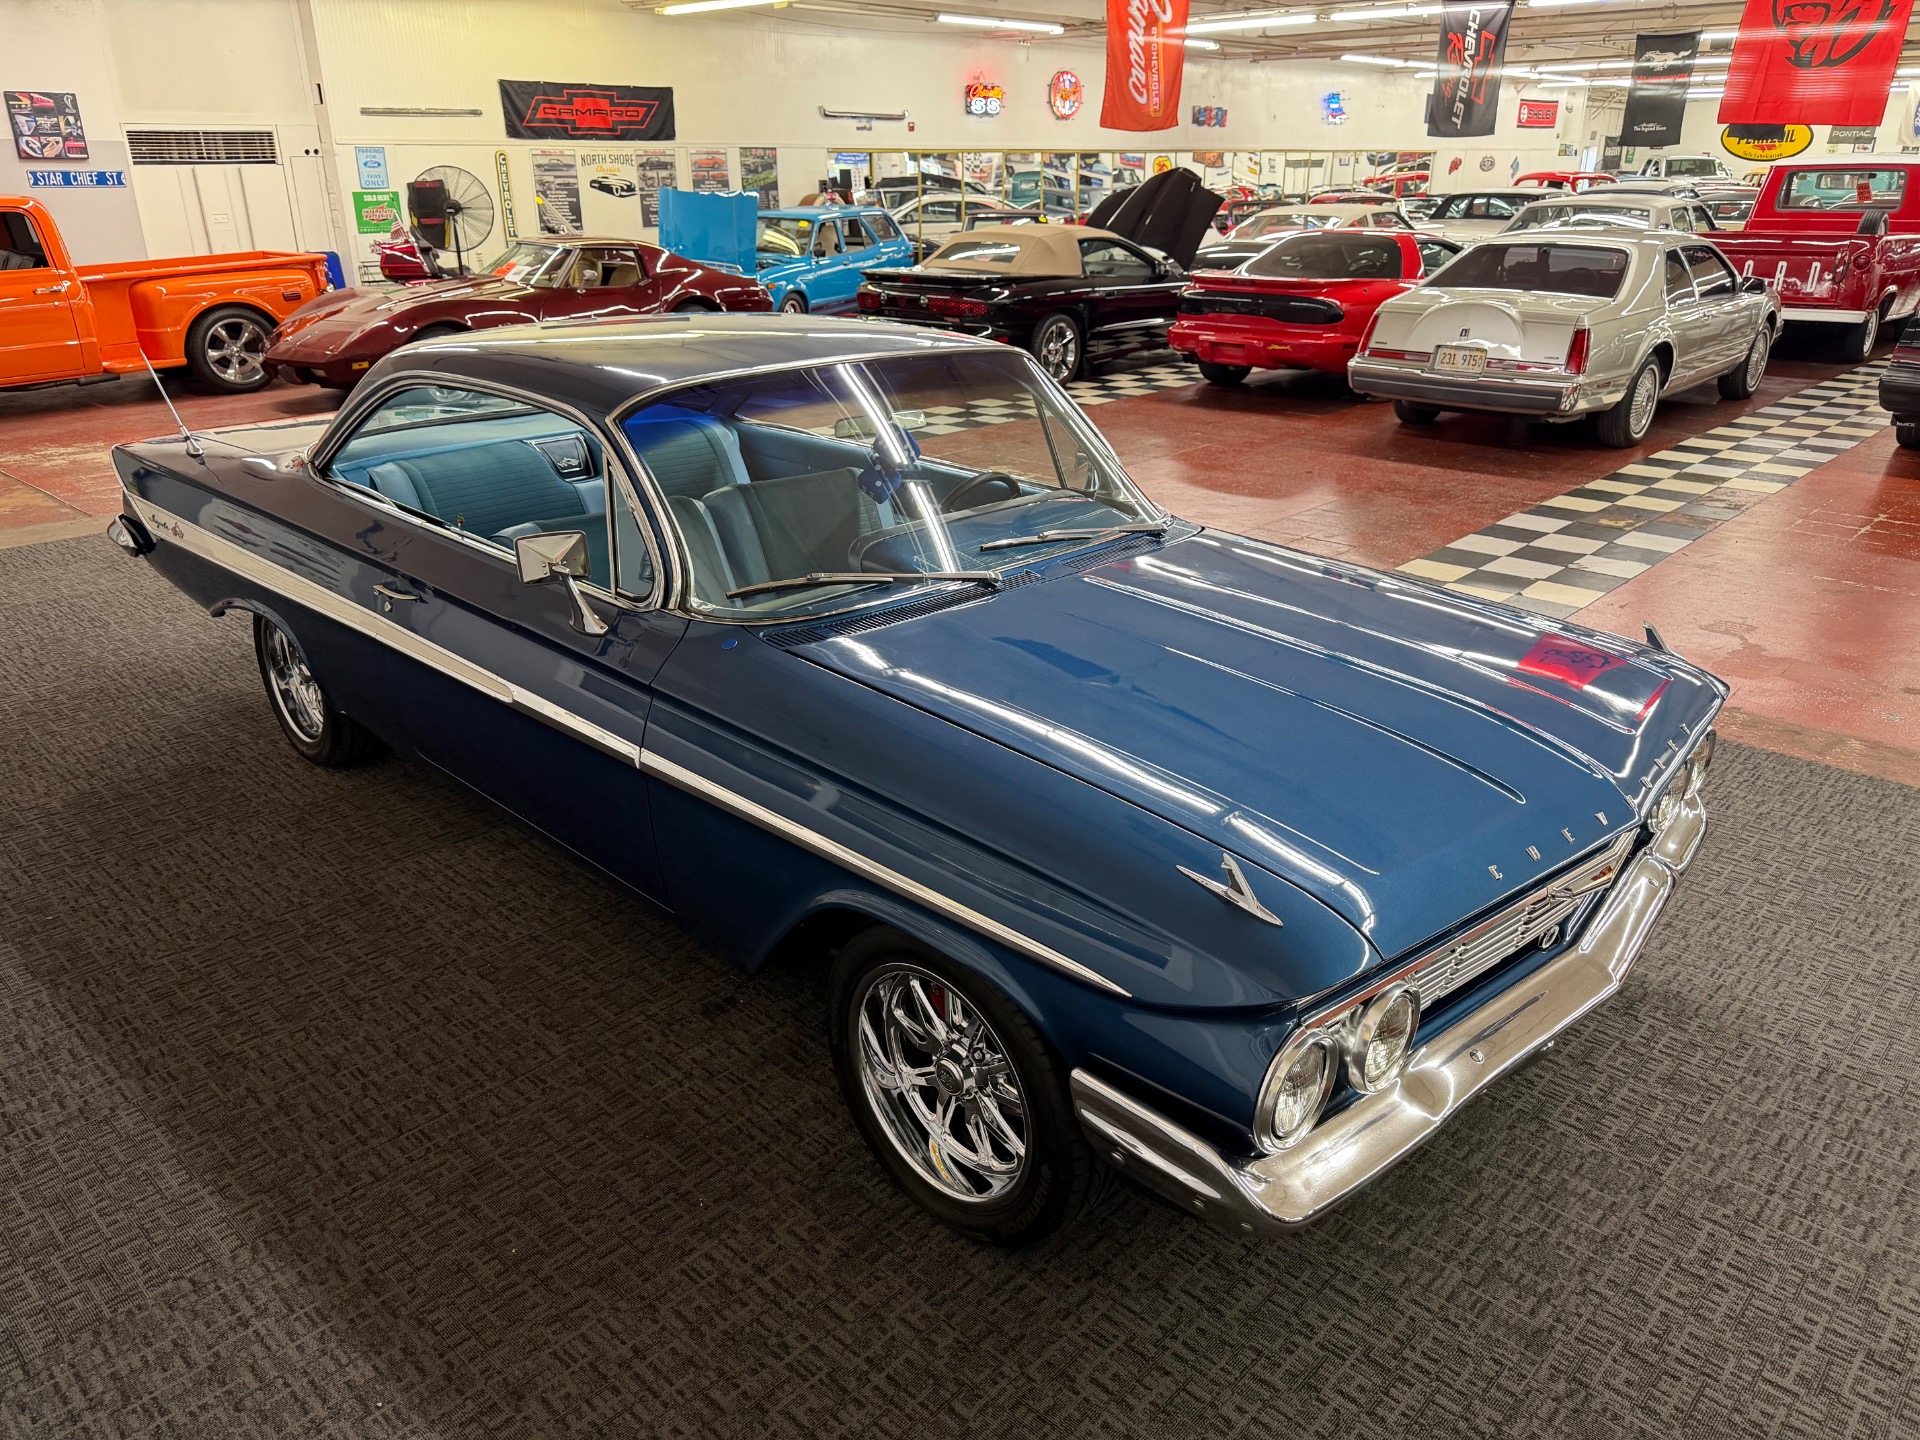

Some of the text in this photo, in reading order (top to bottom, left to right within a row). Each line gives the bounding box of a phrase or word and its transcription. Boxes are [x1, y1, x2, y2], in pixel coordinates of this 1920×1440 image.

[1451, 9, 1481, 129] CHEVROLET
[1151, 43, 1160, 111] CHEVROLET
[542, 106, 641, 119] CAMARO
[971, 97, 1000, 114] SS
[1528, 108, 1556, 120] SHELBY
[580, 154, 635, 167] NORTH SHORE
[36, 172, 118, 186] STAR CHIEF ST
[500, 154, 515, 237] CHEVROLET
[1743, 260, 1821, 292] ORD
[1440, 352, 1456, 365] 231
